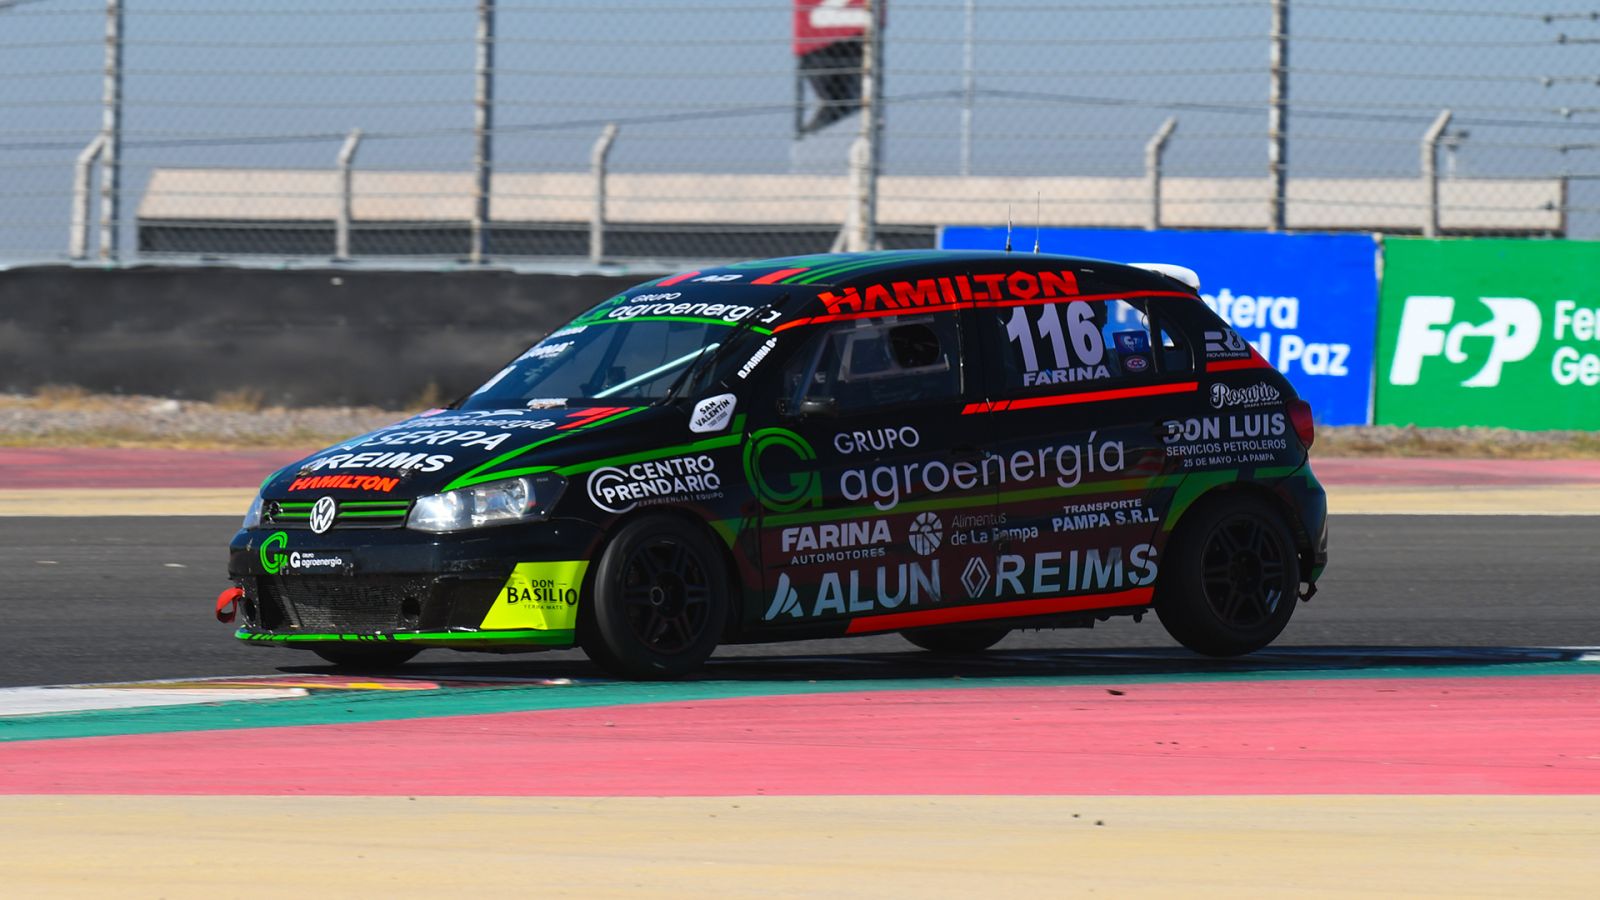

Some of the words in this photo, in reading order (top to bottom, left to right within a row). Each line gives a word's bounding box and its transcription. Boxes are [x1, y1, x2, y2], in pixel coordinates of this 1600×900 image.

[630, 292, 682, 303] GRUPO
[817, 270, 1080, 315] HAMILTON
[1006, 300, 1104, 372] 116
[737, 345, 771, 379] D.FARINA
[1278, 334, 1350, 377] Paz
[1023, 365, 1110, 387] FARINA
[1209, 381, 1280, 409] Rosario
[695, 399, 730, 427] VALENTÍN
[699, 401, 716, 415] SAN
[361, 430, 512, 450] SERPA
[834, 426, 920, 454] GRUPO
[1162, 417, 1221, 444] DON
[1229, 413, 1286, 438] LUIS
[1166, 443, 1221, 457] SERVICIOS
[1223, 439, 1287, 453] PETROLEROS
[1184, 459, 1194, 467] 25
[1196, 458, 1207, 467] DE
[1209, 456, 1232, 465] MAYO
[1238, 455, 1248, 463] LA
[1250, 453, 1275, 462] PAMPA
[313, 452, 455, 472] REIMS
[629, 455, 715, 481] CENTRO
[840, 431, 1125, 511] agroenergía
[288, 475, 399, 492] HAMILTON
[602, 472, 721, 504] PRENDARIO
[1064, 498, 1142, 514] TRANSPORTE
[1052, 513, 1111, 532] PAMPA
[782, 519, 892, 552] FARINA
[951, 532, 967, 545] de
[970, 530, 988, 544] La
[791, 547, 886, 565] AUTOMOTORES
[995, 543, 1158, 597] REIMS
[532, 579, 554, 588] DON
[812, 559, 941, 617] ALUN
[506, 586, 578, 606] BASILIO
